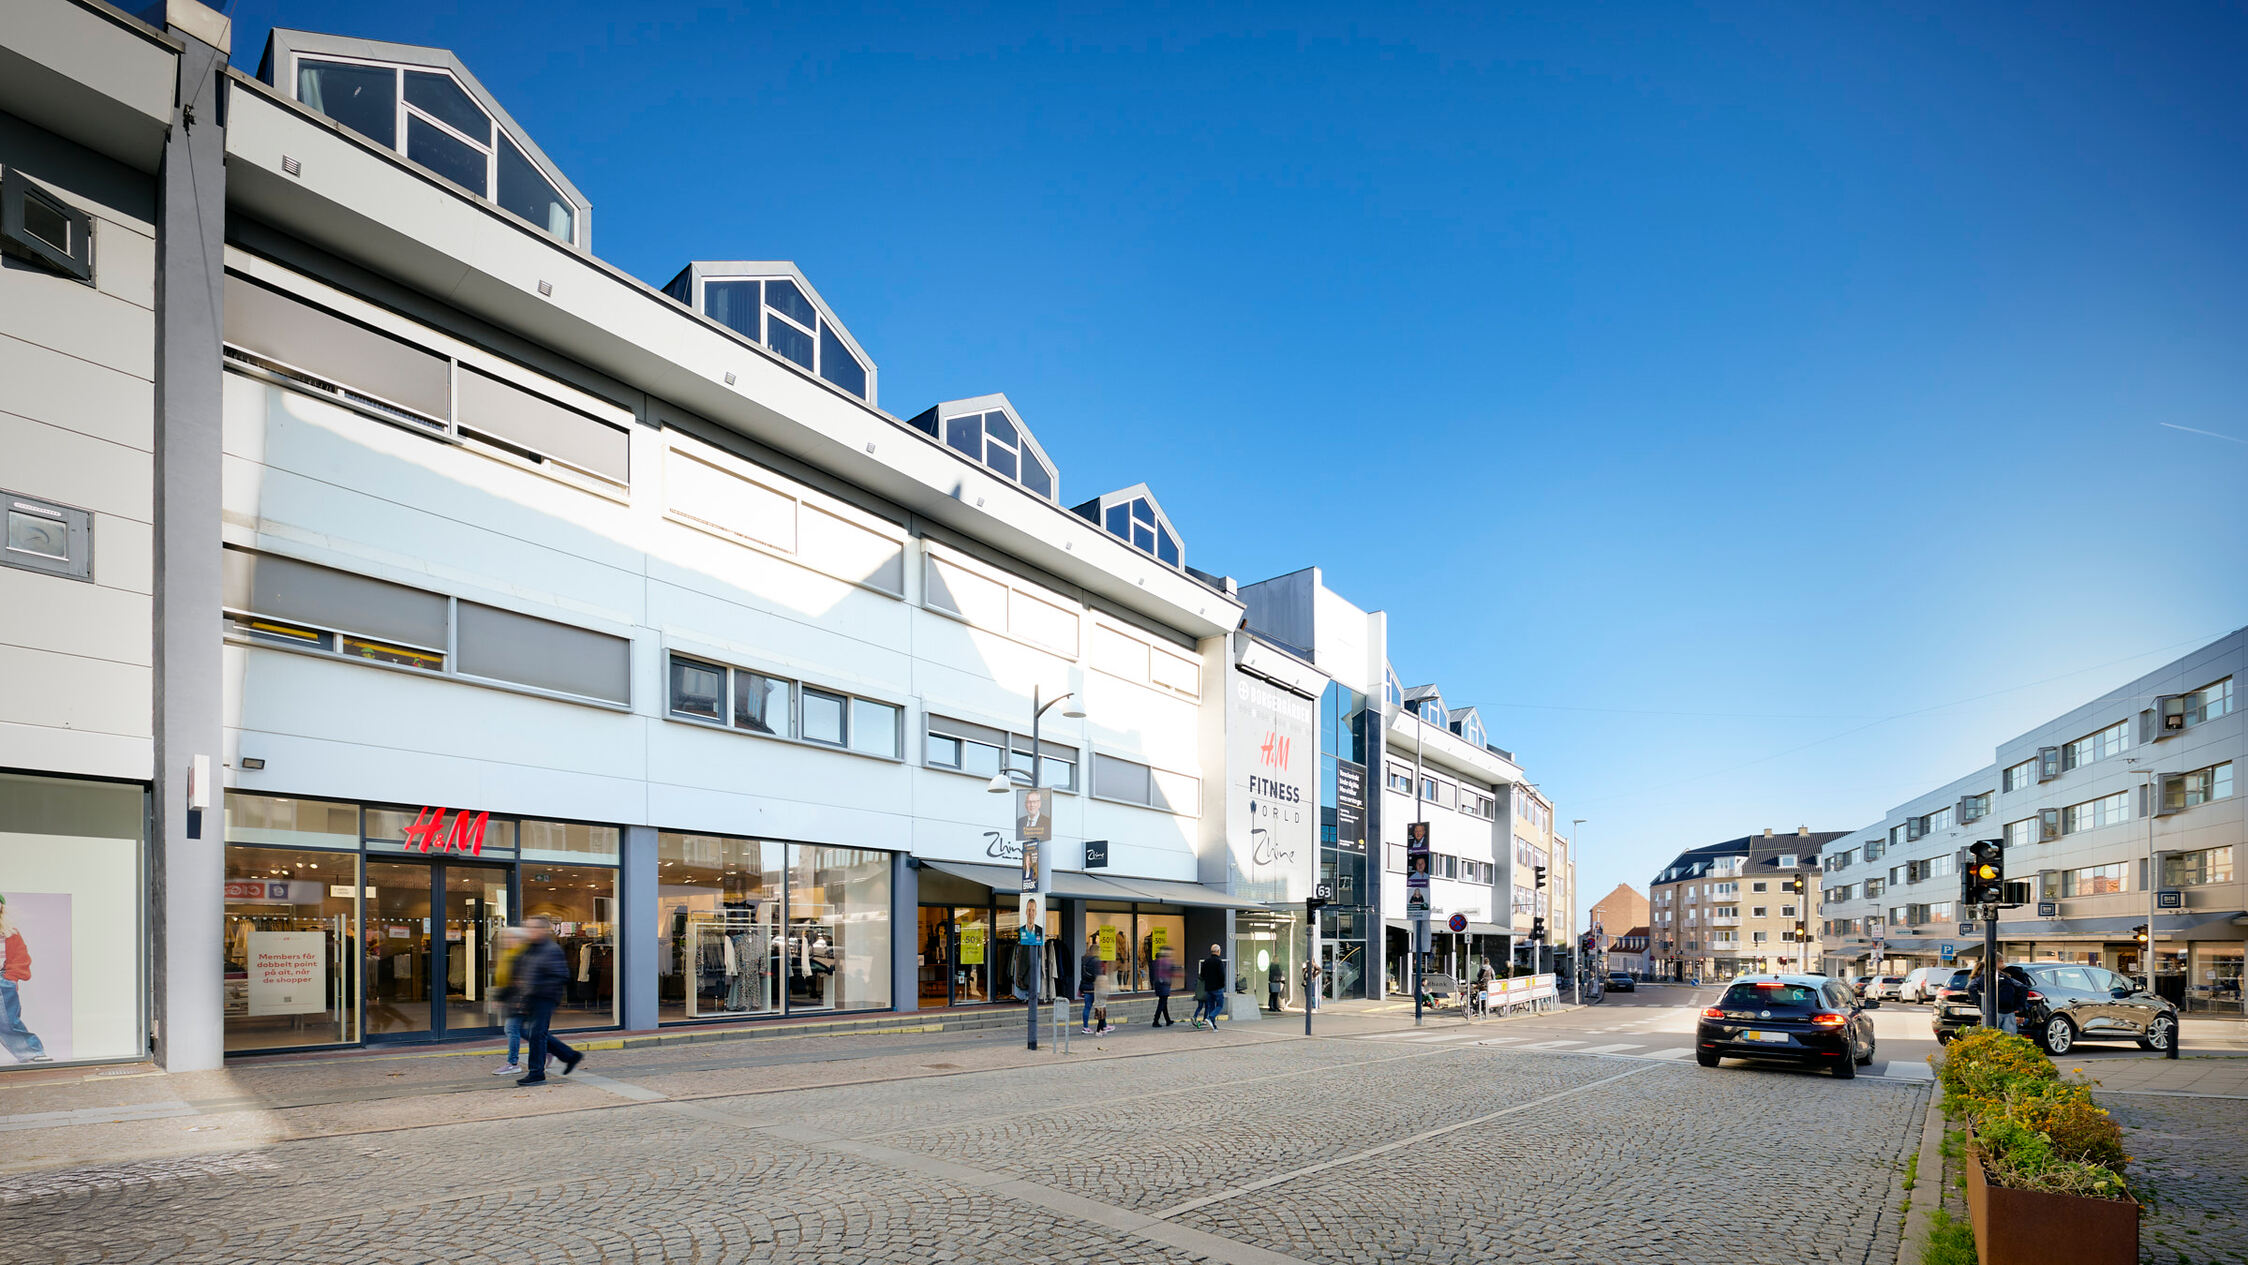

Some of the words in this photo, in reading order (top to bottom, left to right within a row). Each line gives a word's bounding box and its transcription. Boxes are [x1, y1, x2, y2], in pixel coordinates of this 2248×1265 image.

[1260, 730, 1290, 773] H&M
[1249, 774, 1300, 803] FITNESS
[1250, 800, 1300, 823] ORLD
[403, 806, 490, 856] H&M
[983, 831, 1023, 858] Zhin
[1250, 828, 1295, 866] Zhine
[1318, 885, 1331, 898] 63
[264, 969, 276, 977] på
